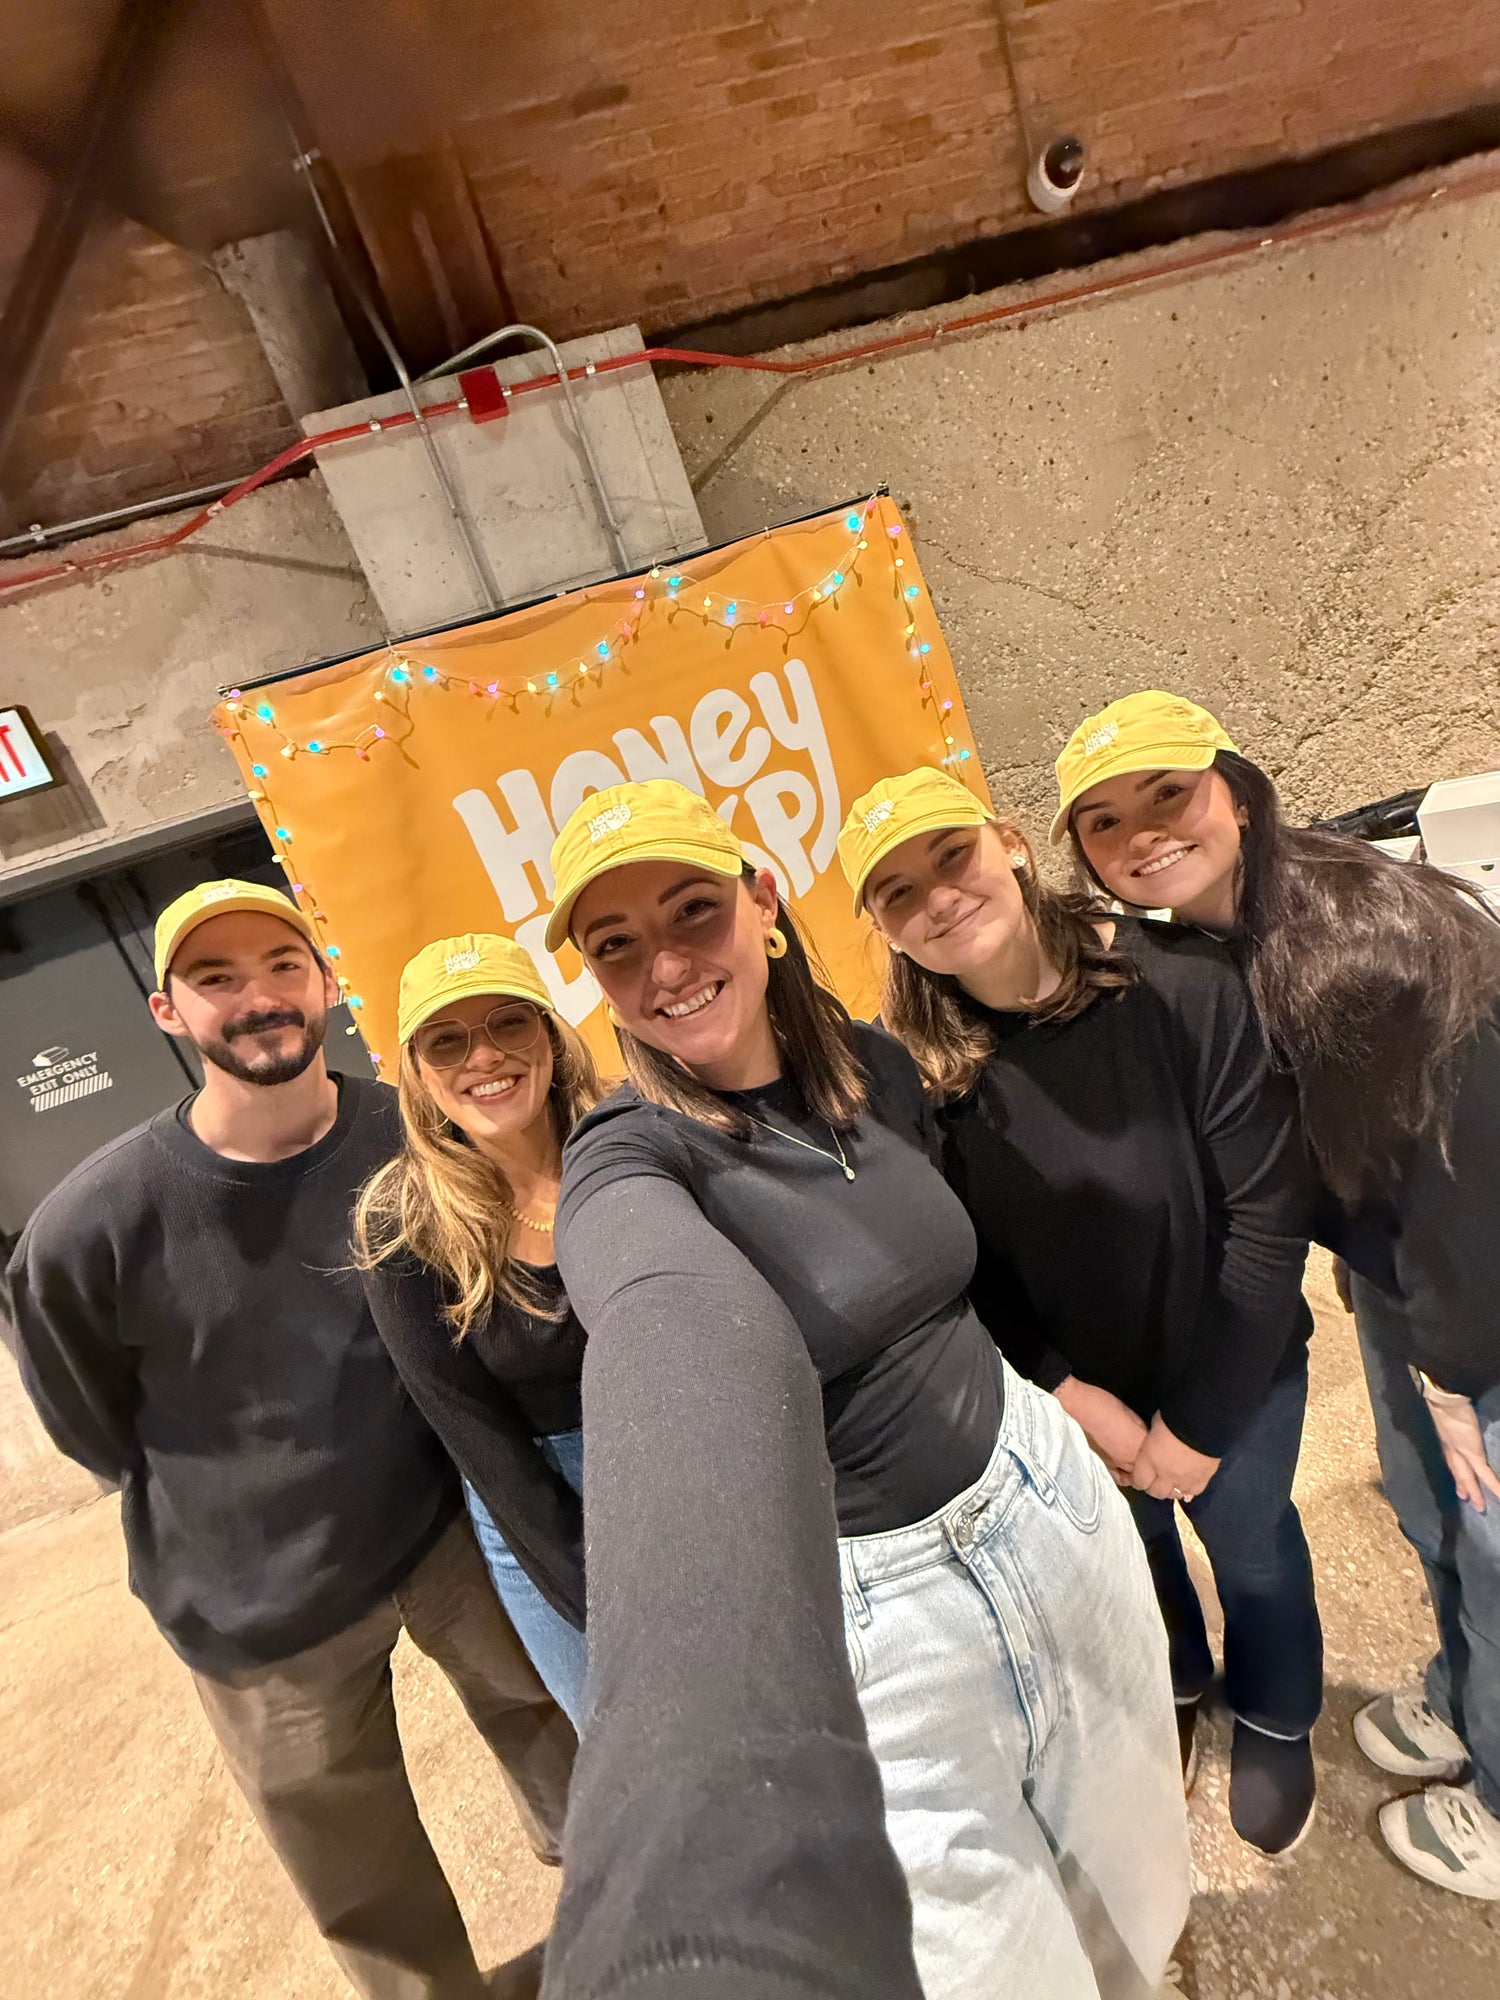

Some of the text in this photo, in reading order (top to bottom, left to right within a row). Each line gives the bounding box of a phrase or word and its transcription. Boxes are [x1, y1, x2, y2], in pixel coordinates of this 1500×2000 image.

[514, 770, 817, 1029] DP
[16, 1051, 98, 1088] EMERGENCY
[29, 1064, 98, 1096] EXIT ONLY
